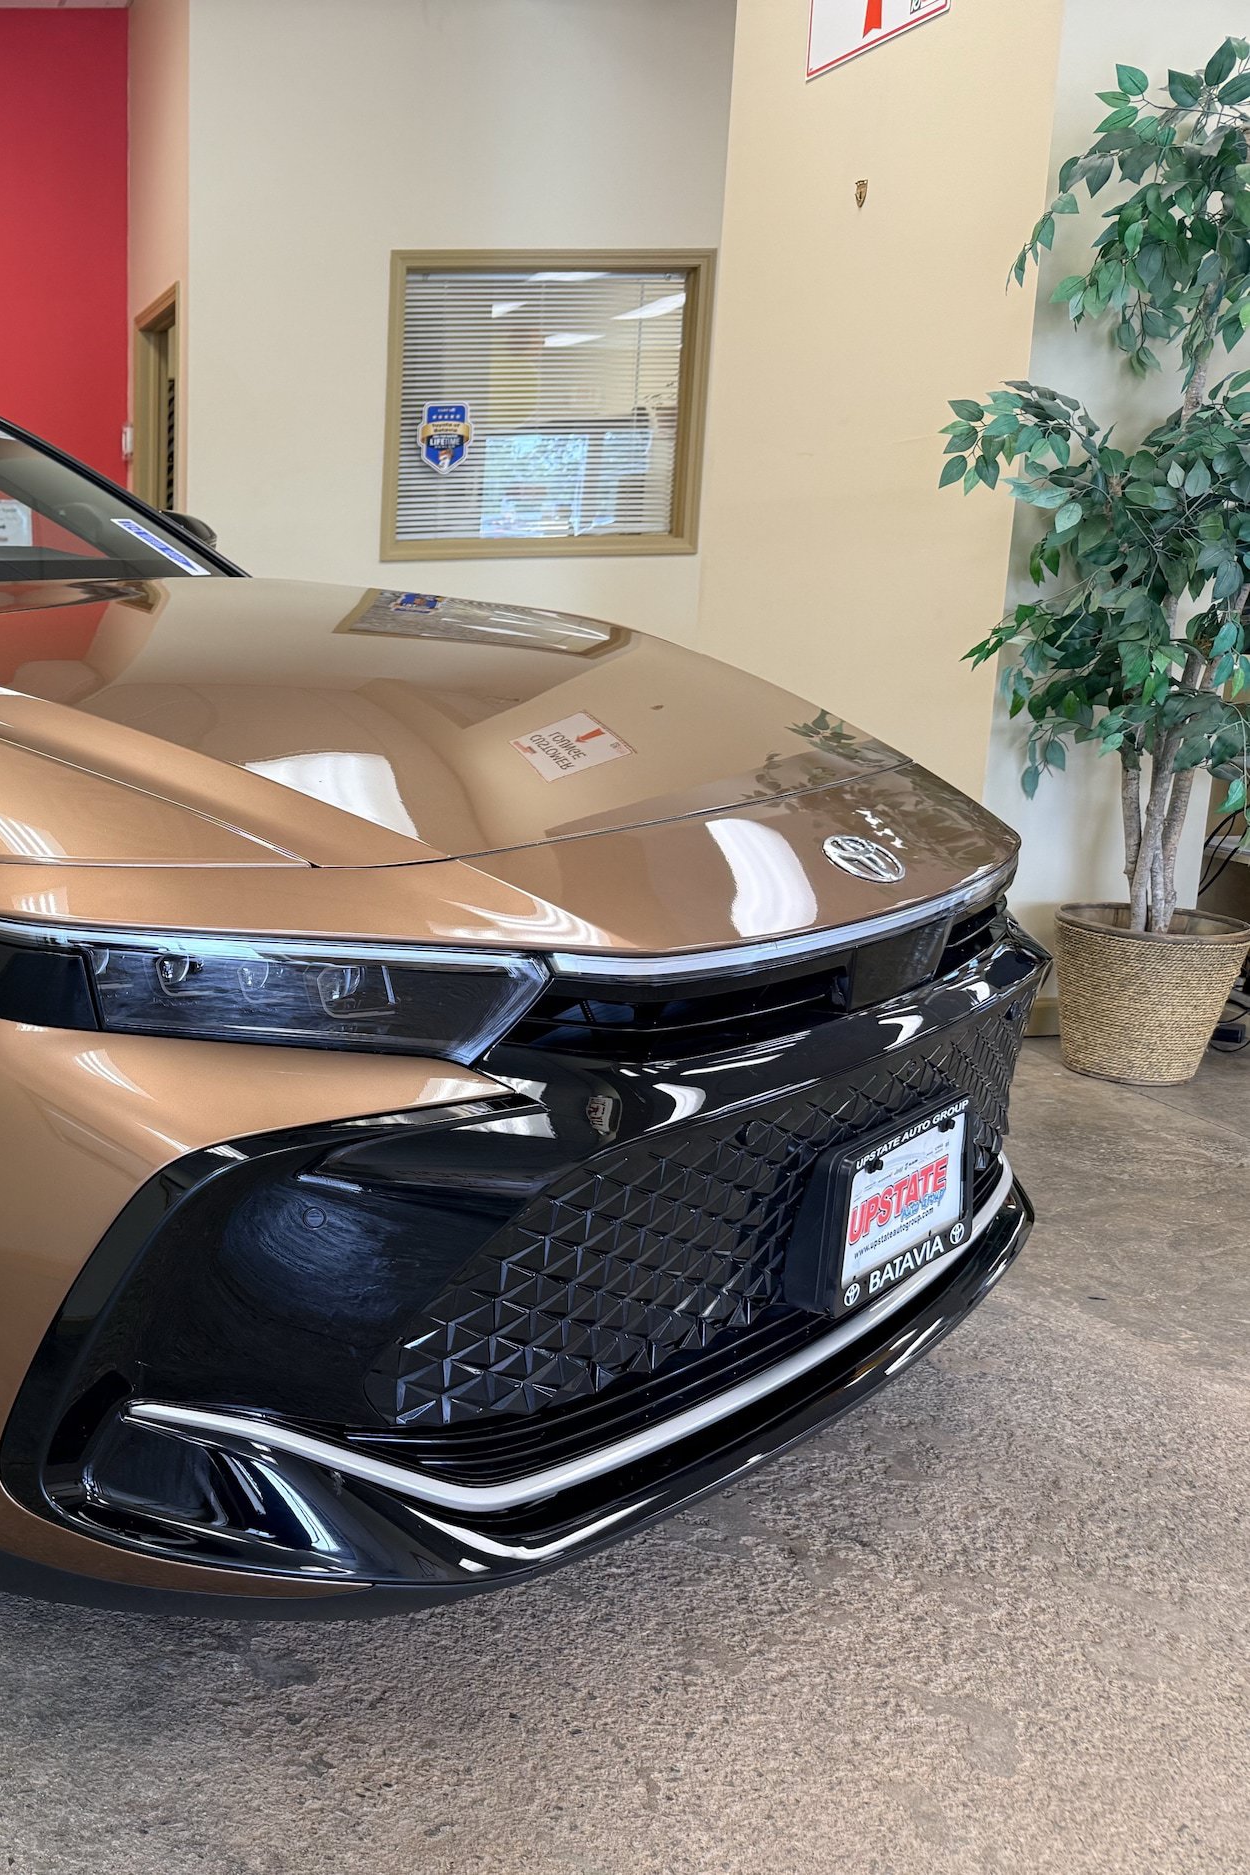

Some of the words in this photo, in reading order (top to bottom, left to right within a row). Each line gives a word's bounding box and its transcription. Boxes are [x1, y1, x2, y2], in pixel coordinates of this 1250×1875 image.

[856, 1136, 901, 1170] UPSTATE
[901, 1119, 931, 1143] AUTO
[932, 1099, 969, 1125] GROUP
[848, 1153, 950, 1246] UPSTATE
[853, 1207, 934, 1260] www.upstateautogroup.com
[869, 1235, 945, 1294] BATAVIA
